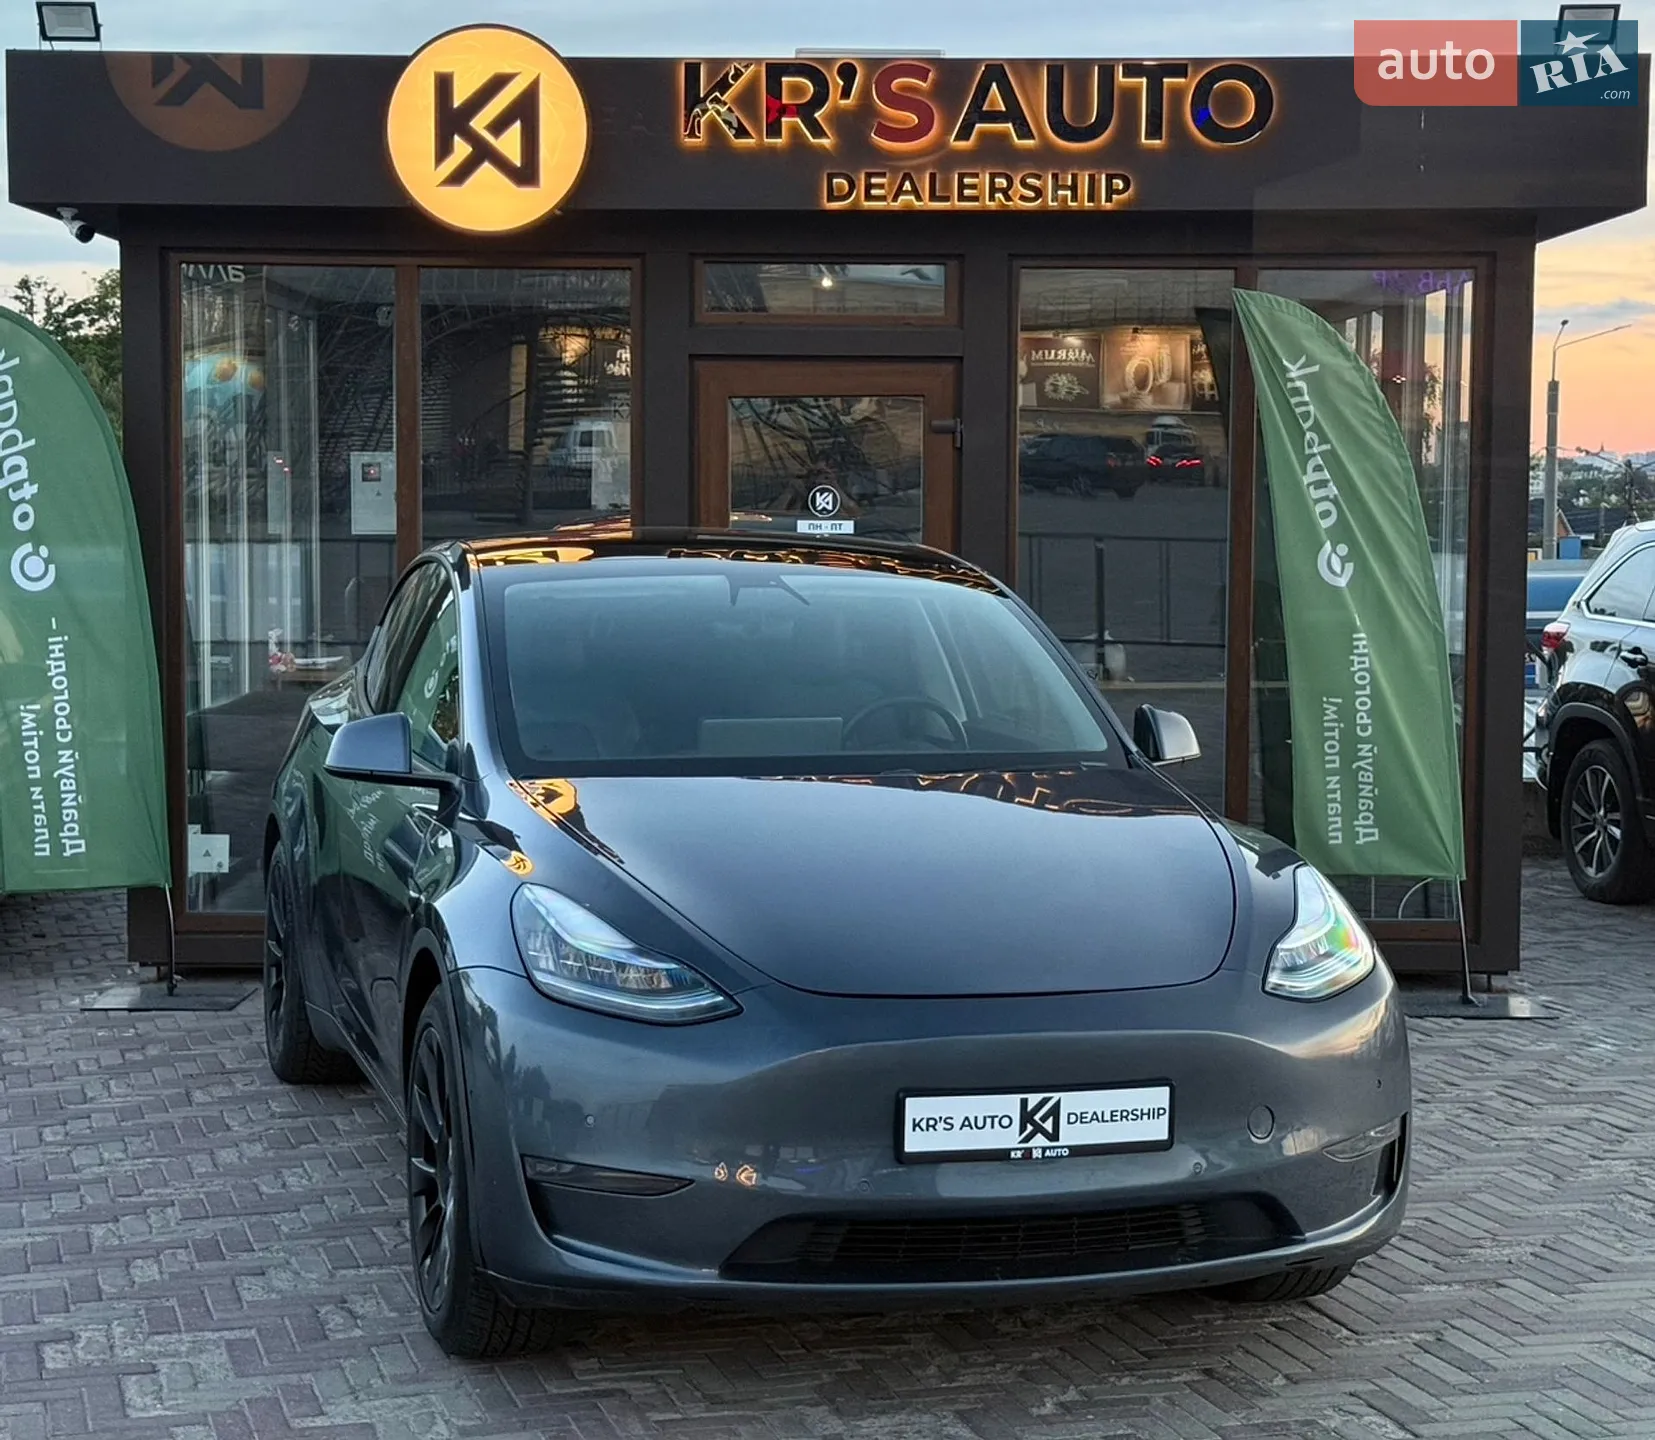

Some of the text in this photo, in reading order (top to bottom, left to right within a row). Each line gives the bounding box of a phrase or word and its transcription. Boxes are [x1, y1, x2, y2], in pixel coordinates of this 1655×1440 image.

[682, 60, 1275, 145] KR'S AUTO
[824, 171, 1132, 206] DEALERSHIP
[911, 1115, 955, 1133] KR'S
[959, 1113, 1014, 1132] AUTO
[1066, 1107, 1167, 1126] DEALERSHIP
[1010, 1149, 1031, 1160] KR'
[1044, 1147, 1070, 1157] AUTO
